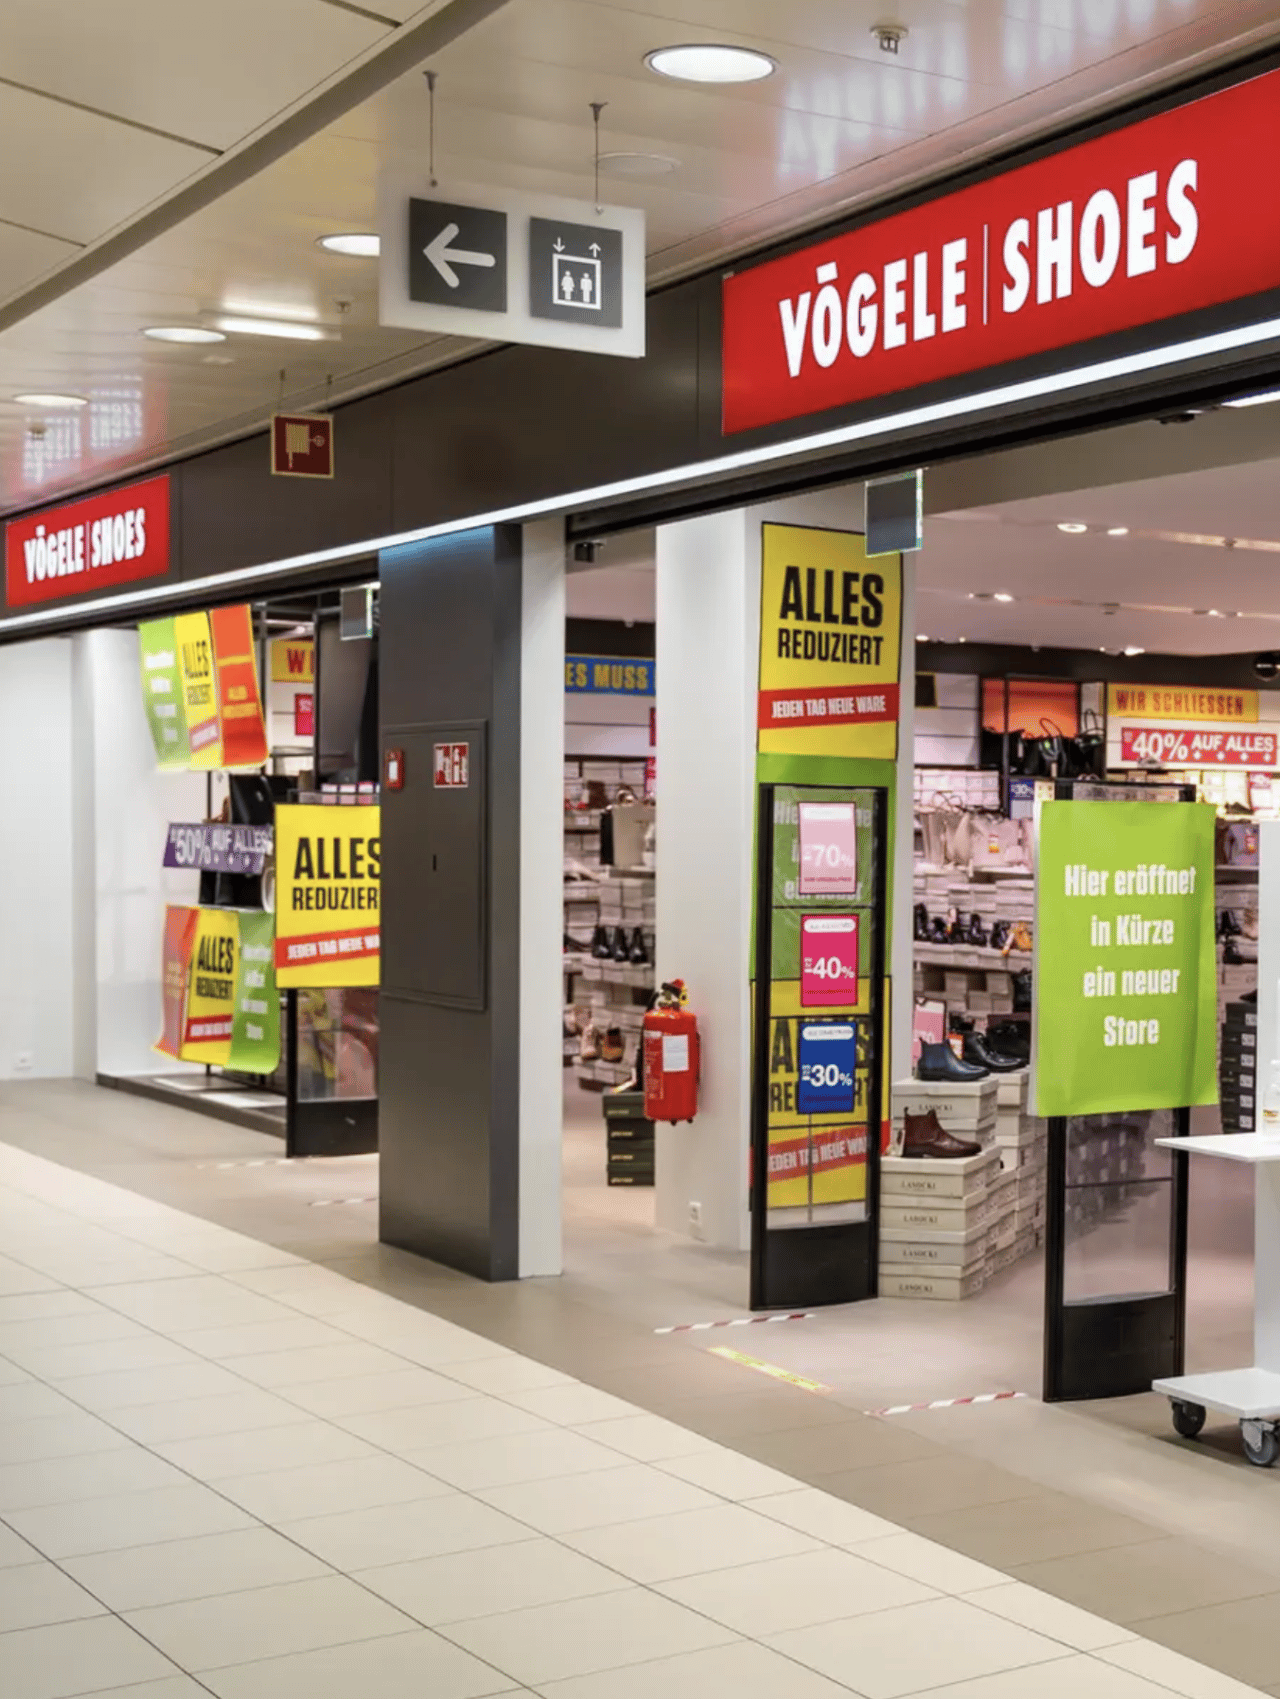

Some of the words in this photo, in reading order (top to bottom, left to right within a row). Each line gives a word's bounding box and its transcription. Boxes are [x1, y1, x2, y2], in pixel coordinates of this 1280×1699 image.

[1003, 158, 1199, 313] SHOES
[92, 507, 146, 568] SHOES
[779, 565, 884, 628] ALLES
[778, 628, 884, 666] REDUZIERT
[594, 664, 647, 689] MUSS
[771, 700, 804, 718] JEDEN
[805, 698, 826, 716] TAG
[828, 697, 855, 715] NEUE
[856, 695, 886, 713] WARE
[1116, 689, 1145, 711] WIR
[1153, 692, 1243, 715] SCHLIESSEN
[1132, 732, 1188, 761] 40%
[1191, 734, 1223, 750] AUF
[1225, 736, 1274, 752] ALLES
[294, 837, 380, 880] ALLES
[1065, 864, 1109, 896] Hier
[1114, 864, 1196, 895] eröffnet
[1091, 915, 1111, 946] in
[1116, 914, 1174, 945] Kürze
[197, 935, 234, 975] ALLES
[804, 956, 855, 979] -40%
[1083, 965, 1116, 997] ein
[1121, 969, 1180, 996] neuer
[1104, 1015, 1159, 1046] Store
[802, 1064, 853, 1087] -30%
